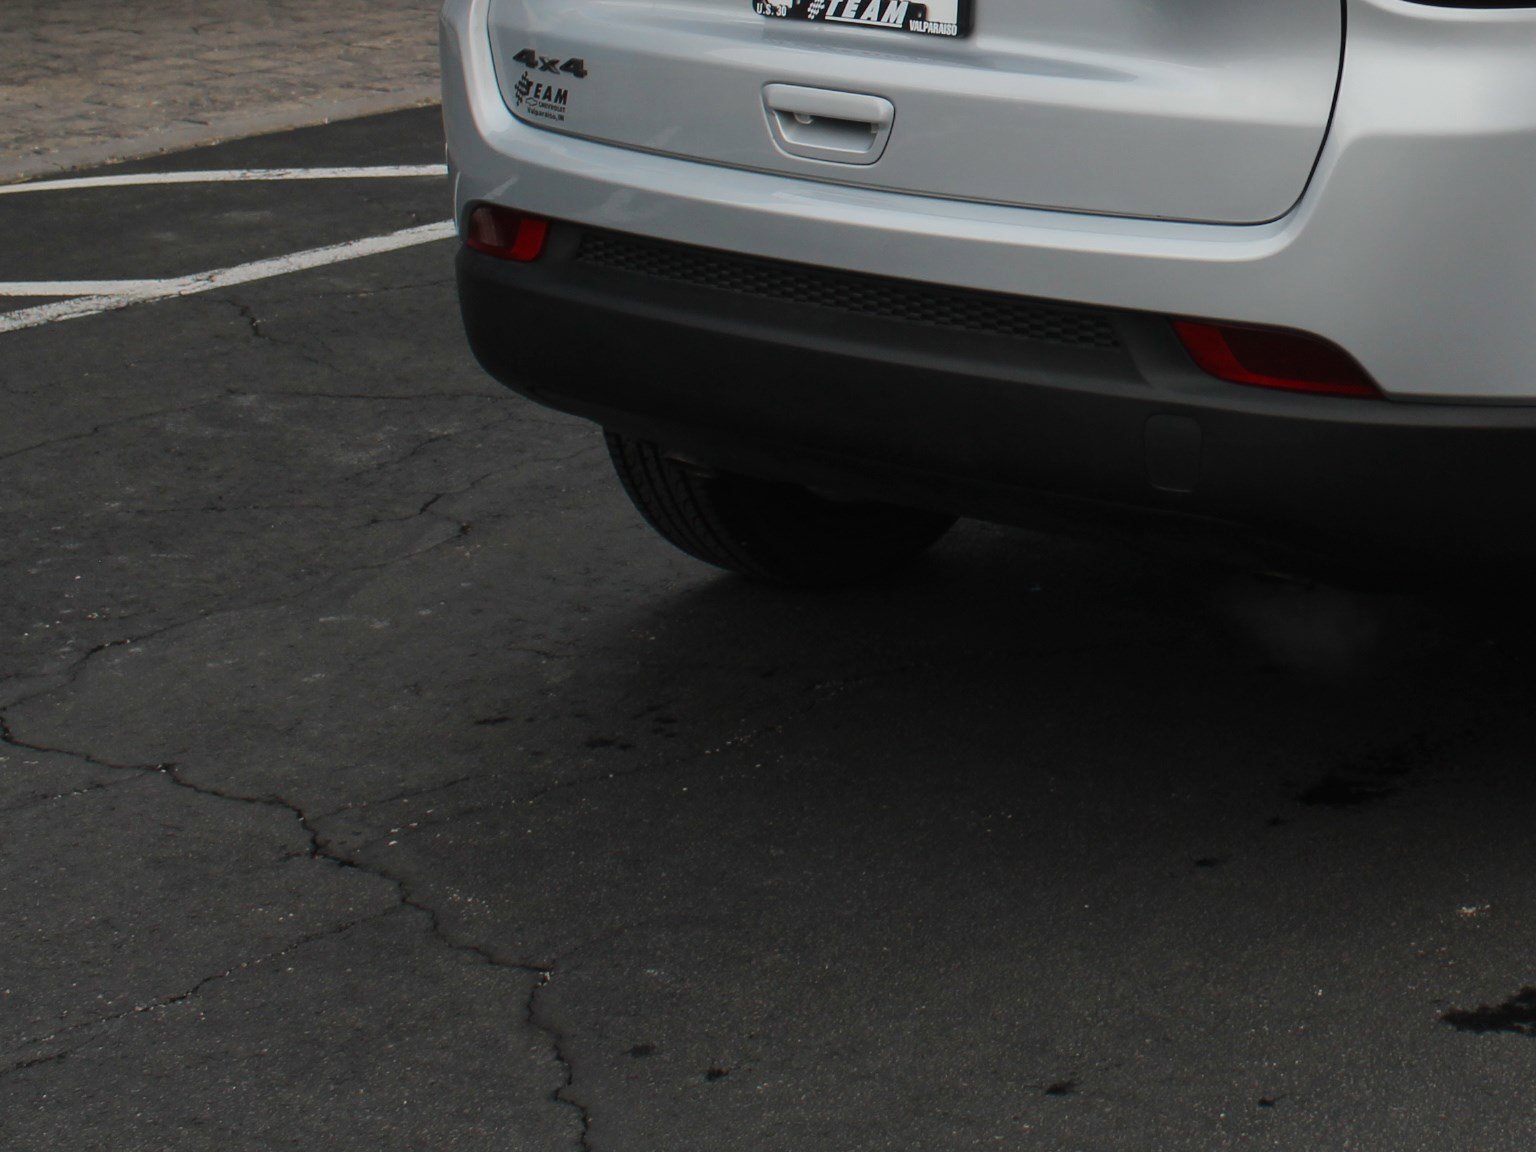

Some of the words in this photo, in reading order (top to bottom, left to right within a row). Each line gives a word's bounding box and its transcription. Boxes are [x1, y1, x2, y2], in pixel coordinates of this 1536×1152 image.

[756, 2, 774, 16] U.S.
[776, 4, 787, 17] 30
[909, 19, 958, 36] VALPARAISO
[512, 48, 588, 78] 4x4
